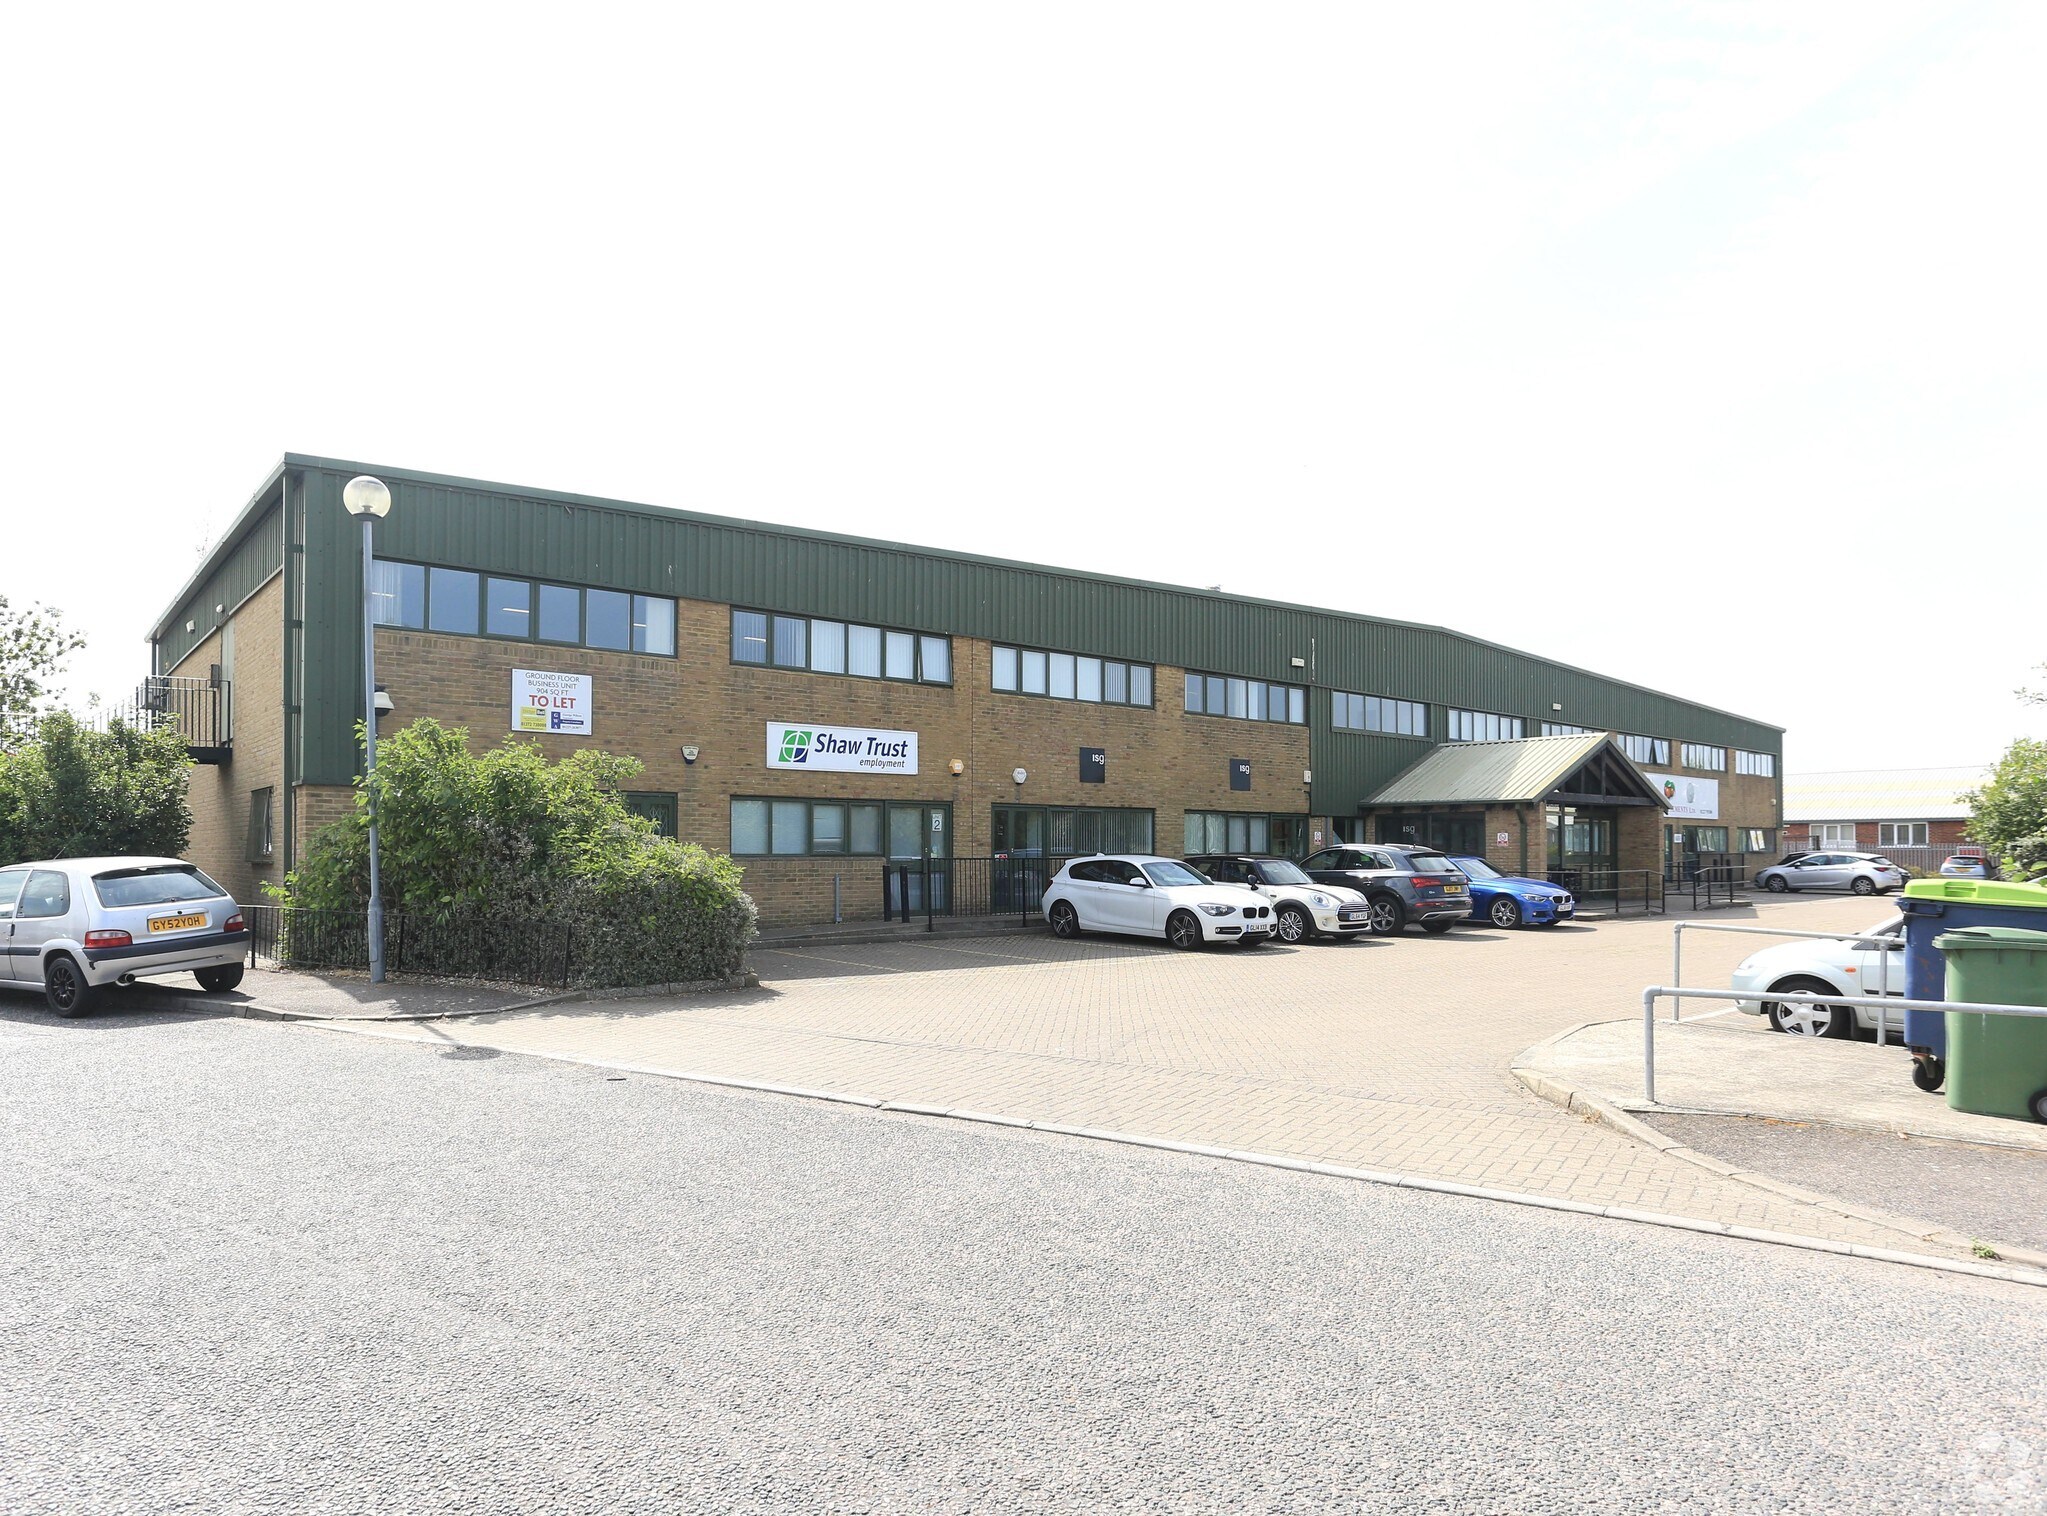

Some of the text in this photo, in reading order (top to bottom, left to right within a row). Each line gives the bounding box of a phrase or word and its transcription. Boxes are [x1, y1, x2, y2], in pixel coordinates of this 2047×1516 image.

[525, 671, 580, 683] GROUND FLOOR
[528, 679, 577, 690] BUSINESS UNIT
[536, 687, 549, 695] 904
[549, 688, 560, 697] SQ
[528, 694, 576, 709] TO LET
[814, 732, 909, 758] Shaw Trust
[859, 757, 905, 769] employment
[933, 819, 941, 830] 2
